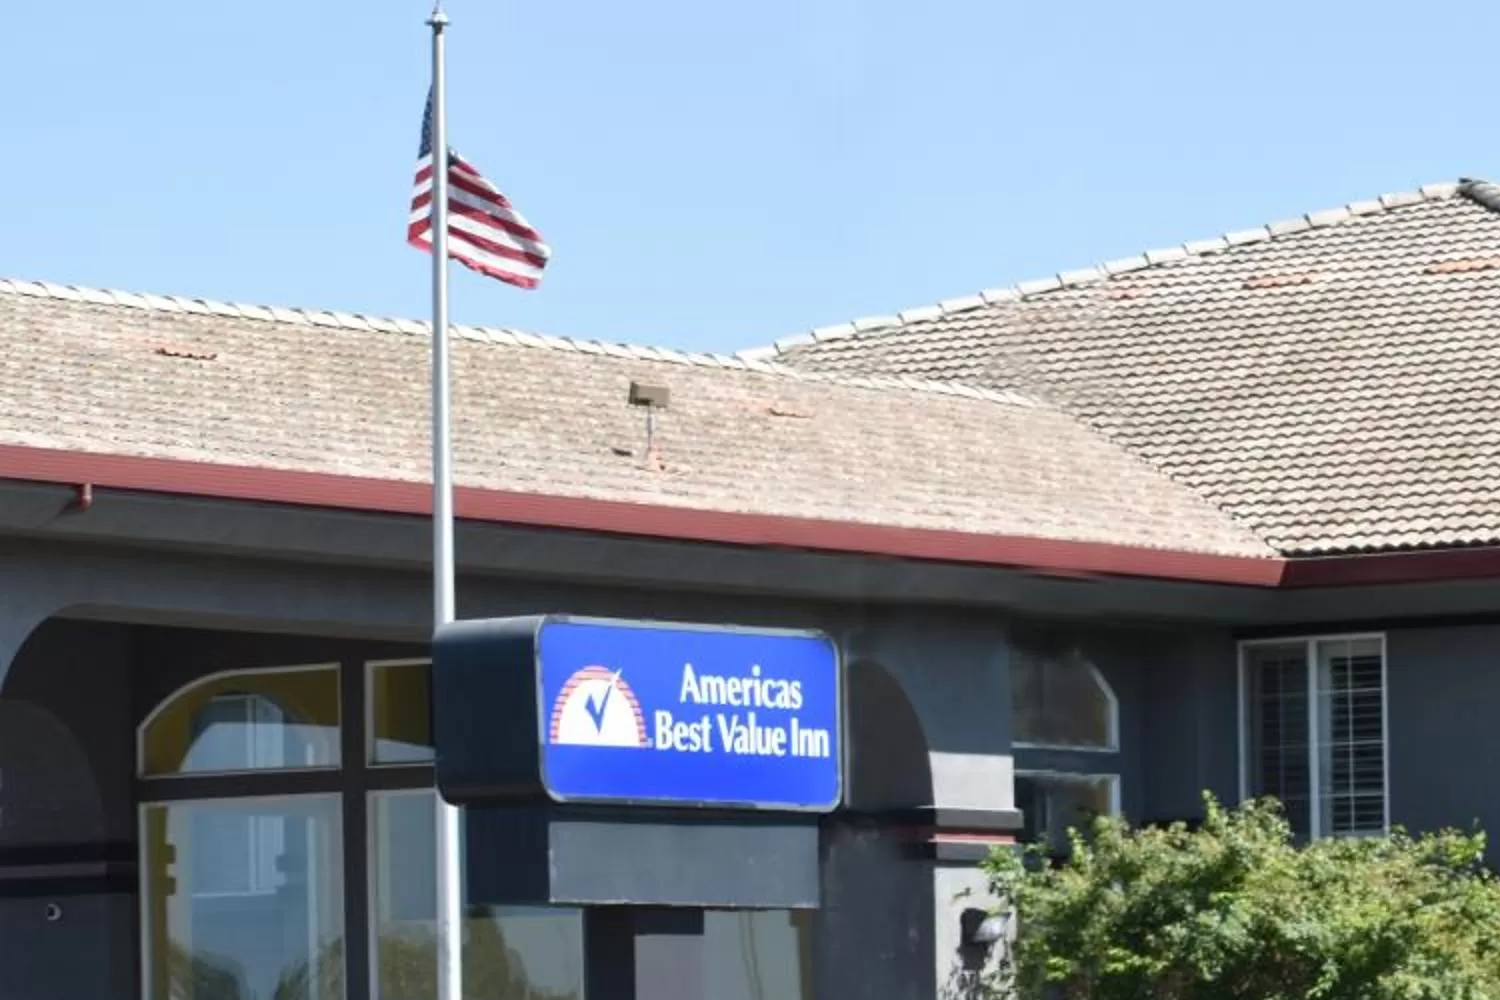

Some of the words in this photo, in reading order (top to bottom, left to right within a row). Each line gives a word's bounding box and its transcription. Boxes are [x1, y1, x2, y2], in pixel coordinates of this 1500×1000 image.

[680, 663, 803, 709] Americas
[655, 709, 712, 753] Best
[717, 711, 787, 756] Value
[791, 717, 830, 758] Inn
